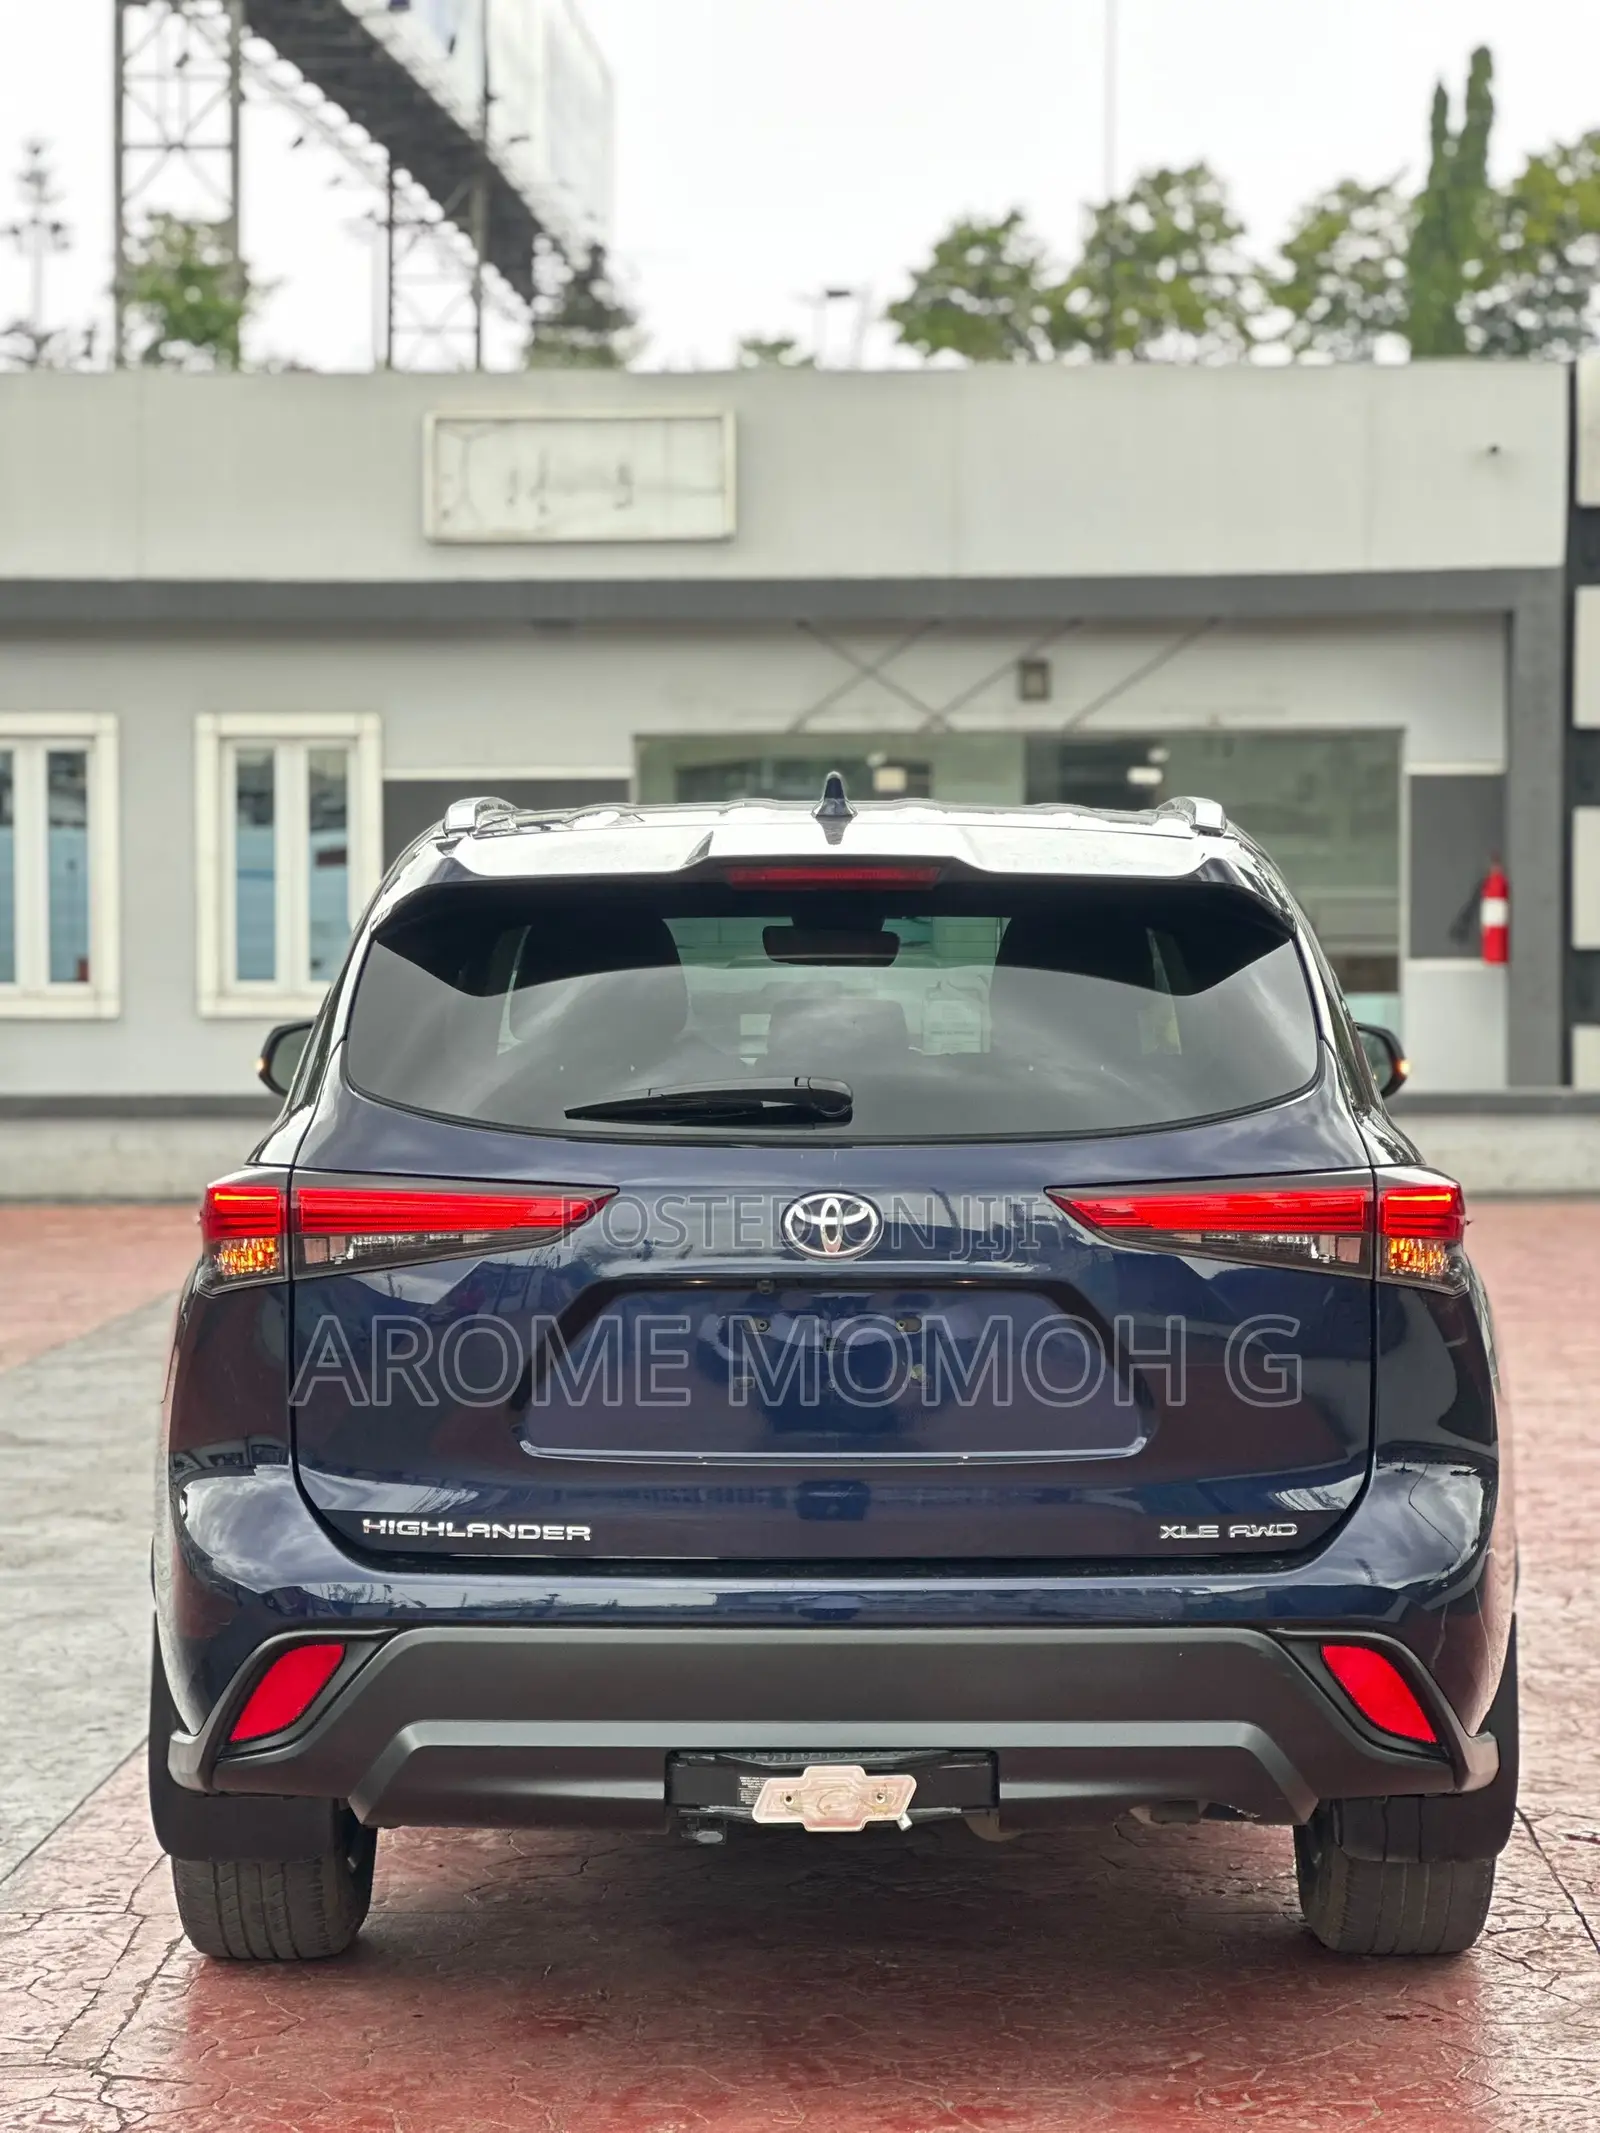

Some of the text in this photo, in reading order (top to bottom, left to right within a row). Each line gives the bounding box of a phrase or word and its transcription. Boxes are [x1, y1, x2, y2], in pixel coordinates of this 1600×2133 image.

[362, 1518, 592, 1542] HIGHLANDER
[1159, 1523, 1298, 1539] XLE AWD
